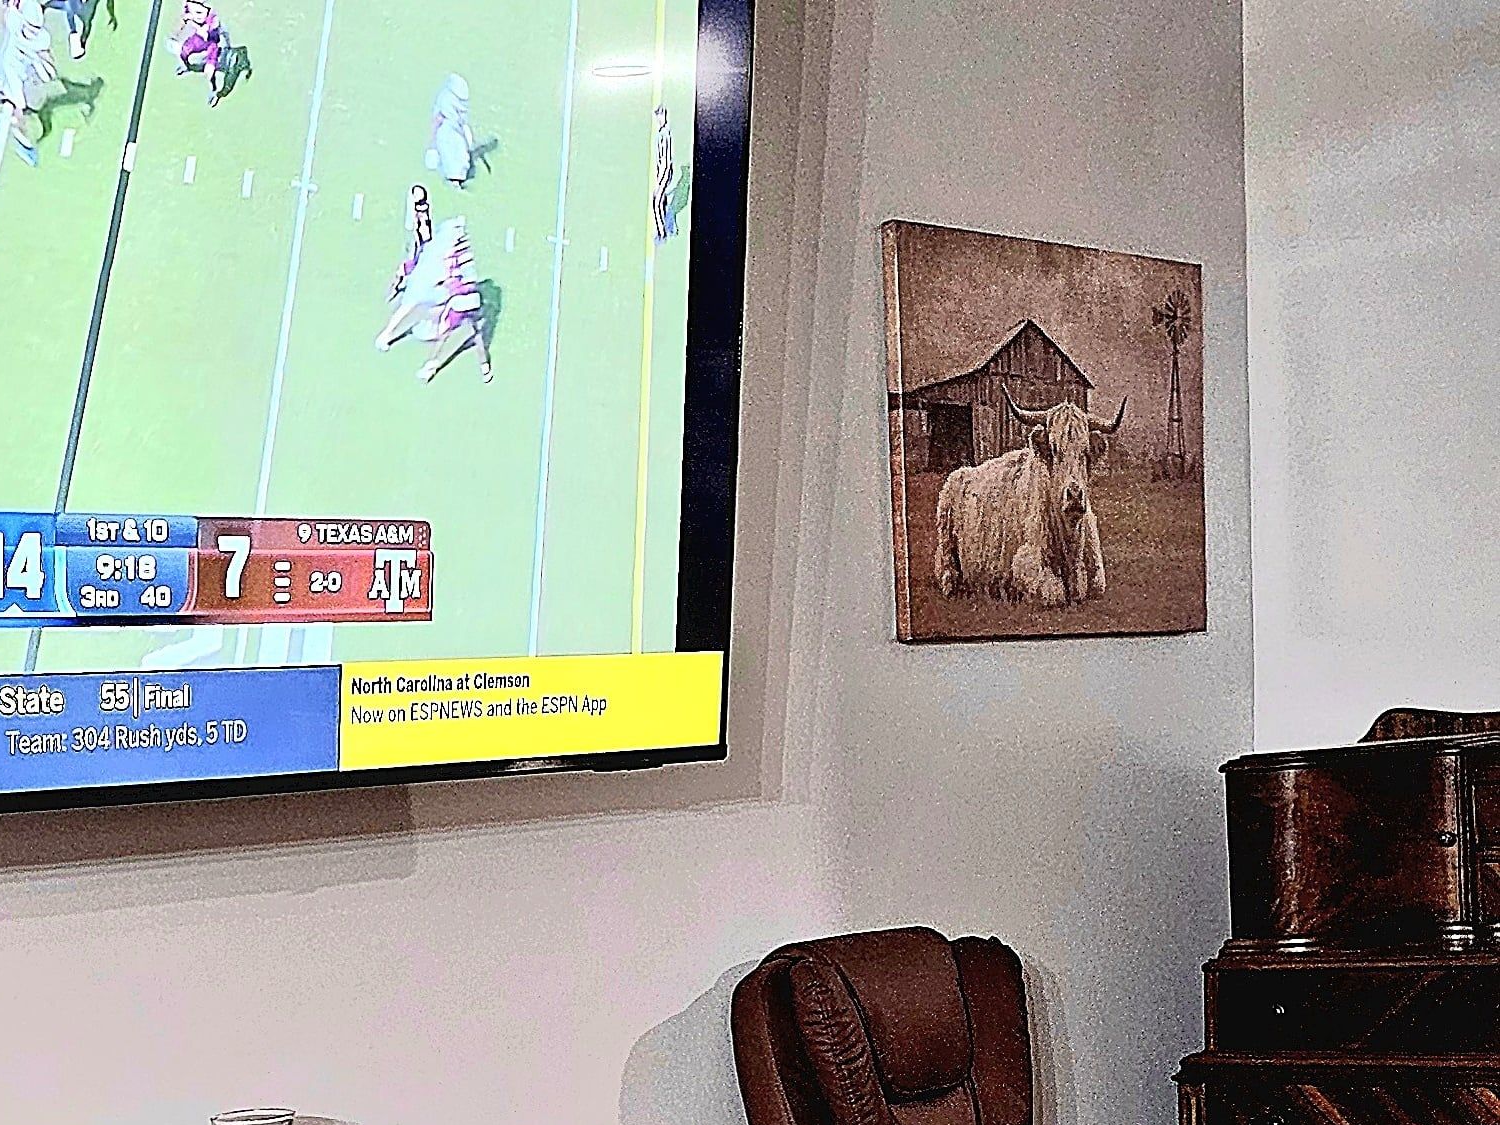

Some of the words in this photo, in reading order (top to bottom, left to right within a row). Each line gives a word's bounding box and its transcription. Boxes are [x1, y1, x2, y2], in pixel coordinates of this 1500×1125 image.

[87, 518, 119, 541] 1ST
[122, 519, 140, 541] &
[144, 519, 168, 542] 10
[297, 523, 312, 544] 9
[316, 523, 373, 544] TEXAS
[374, 524, 414, 544] A&M
[96, 554, 157, 581] 9:18
[217, 535, 251, 599] 7
[80, 586, 119, 608] 3RD
[140, 586, 172, 608] 40
[143, 683, 192, 711] Final
[351, 675, 392, 695] North
[396, 674, 453, 693] Carolina
[456, 674, 470, 691] at
[473, 672, 530, 690] Clemson
[0, 685, 65, 716] State
[100, 682, 131, 712] 55
[350, 704, 384, 724] Now
[387, 707, 406, 722] on
[410, 699, 483, 721] ESPNEWS
[486, 698, 512, 717] and
[516, 697, 538, 716] the
[541, 695, 578, 714] ESPN
[581, 695, 607, 717] App
[5, 729, 67, 757] Team:
[70, 727, 111, 751] 304
[115, 724, 162, 751] Rush
[164, 722, 202, 752] yds,
[204, 720, 218, 745] 5
[220, 719, 248, 744] TD
